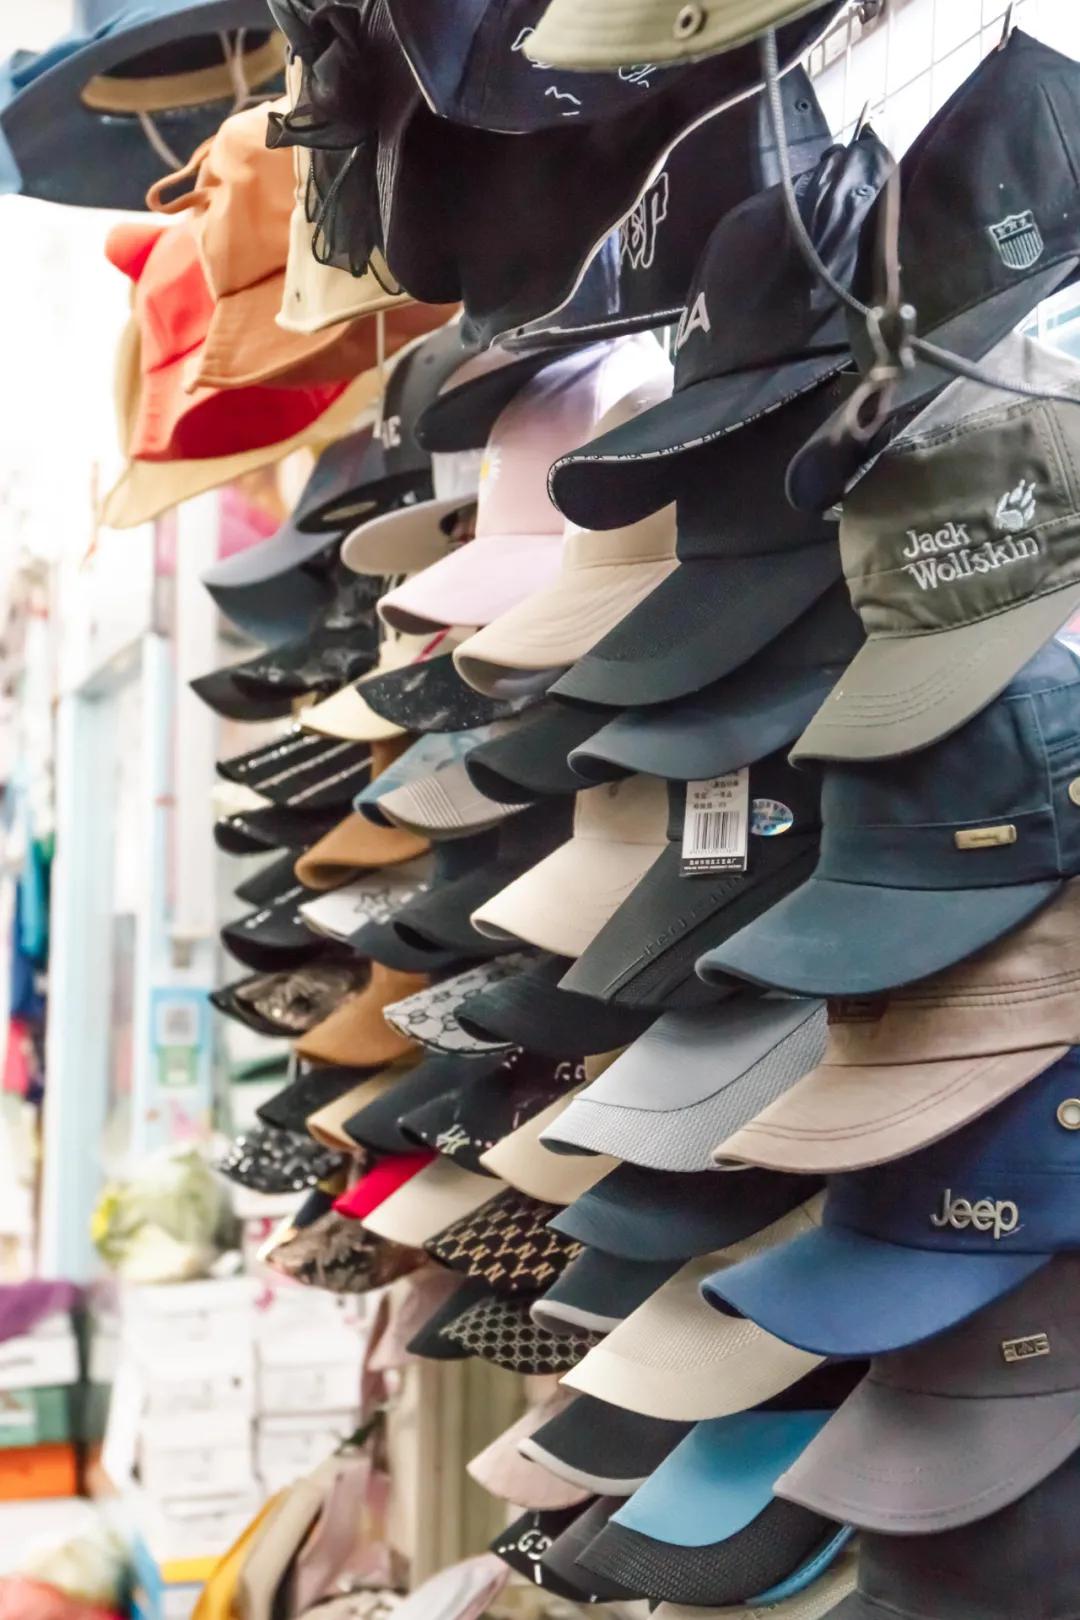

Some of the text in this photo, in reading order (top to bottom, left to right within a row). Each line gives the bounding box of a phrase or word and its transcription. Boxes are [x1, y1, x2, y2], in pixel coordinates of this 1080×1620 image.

[903, 521, 971, 558] Jack
[906, 534, 1039, 591] Wolfskin
[930, 1188, 1019, 1240] Jeep
